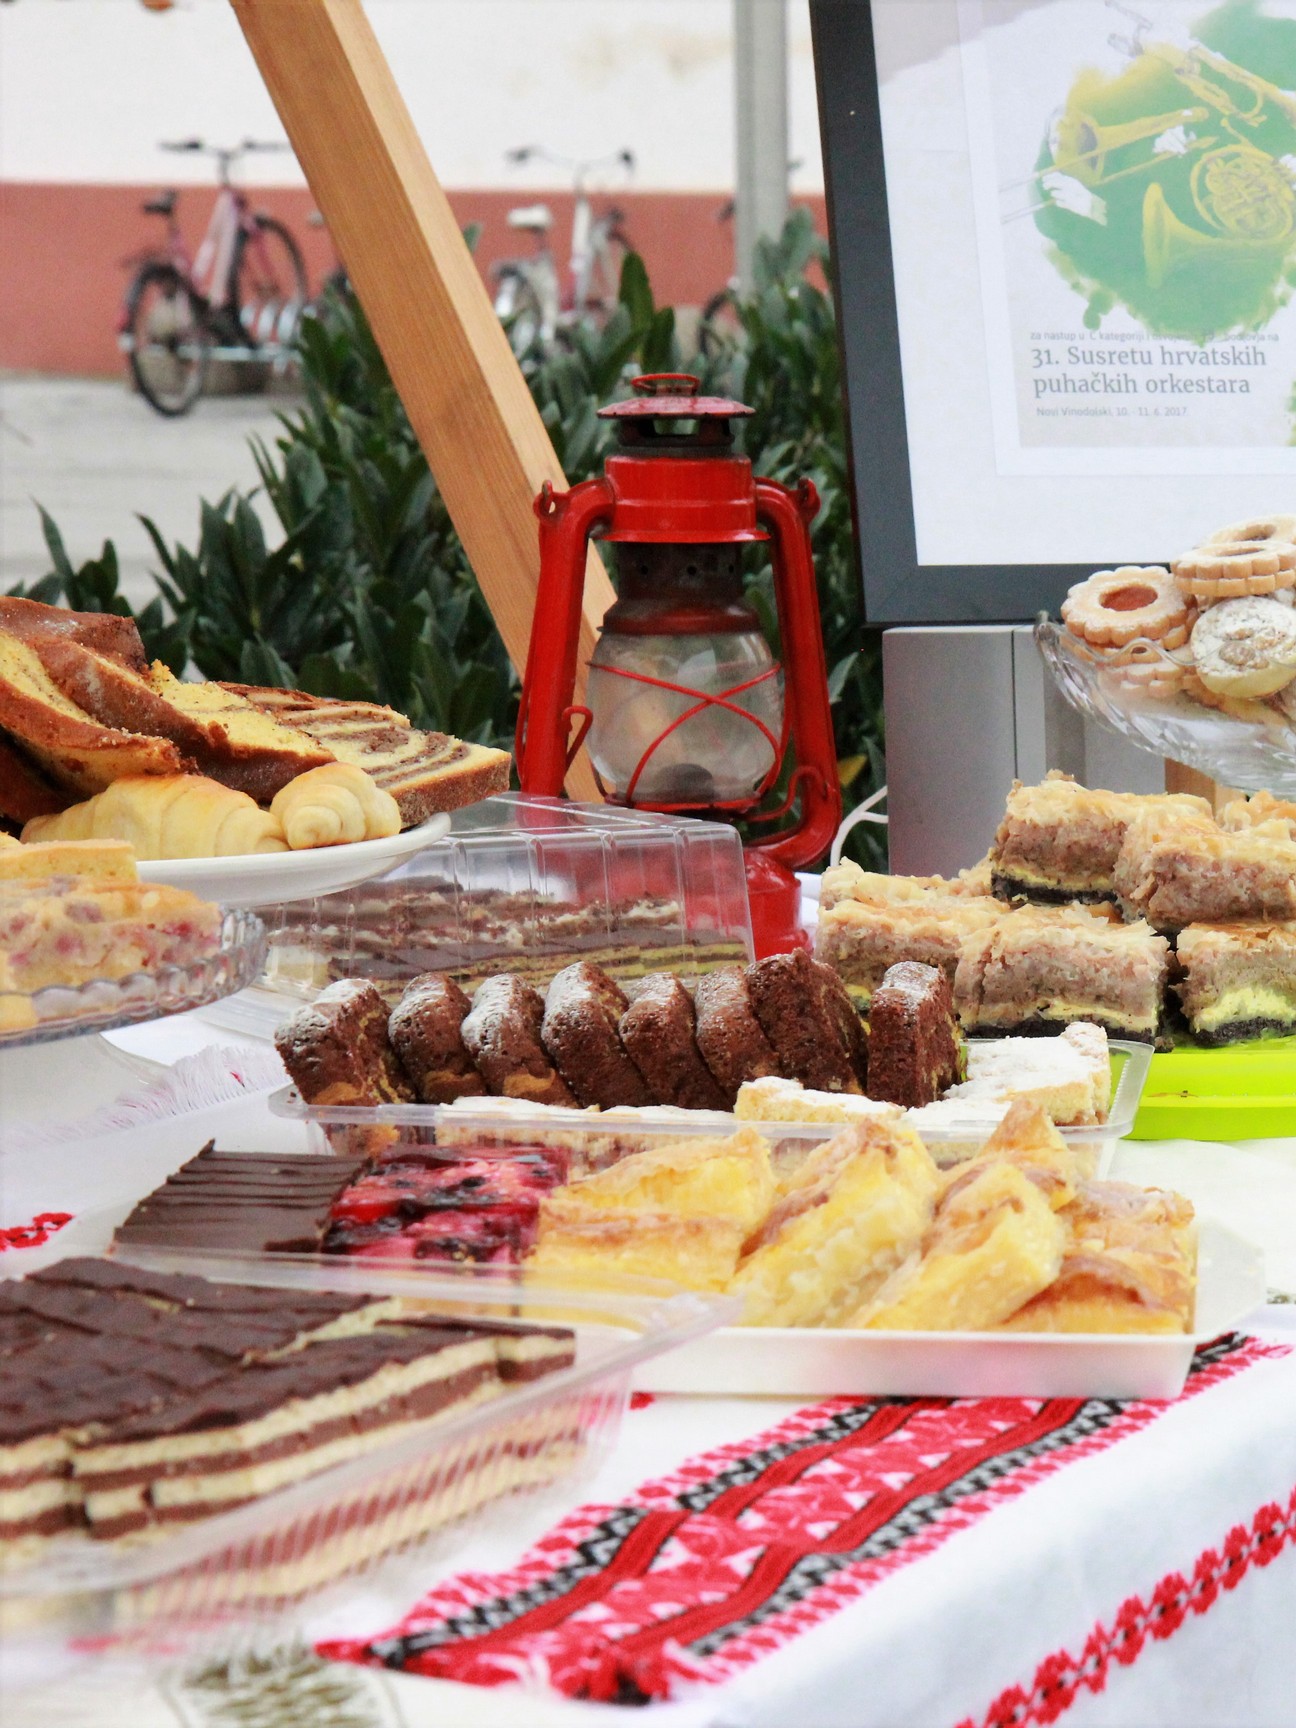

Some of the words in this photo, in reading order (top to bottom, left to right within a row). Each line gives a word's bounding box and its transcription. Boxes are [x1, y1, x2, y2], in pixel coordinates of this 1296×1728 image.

[1030, 332, 1041, 340] za
[1044, 331, 1076, 342] nastup
[1099, 331, 1144, 343] kategoriji
[1031, 348, 1060, 369] 31.
[1067, 346, 1154, 366] Susretu
[1160, 345, 1267, 366] hrvatskih
[1033, 371, 1139, 399] puhačkih
[1145, 372, 1252, 394] orkestara
[1036, 405, 1058, 417] Novi
